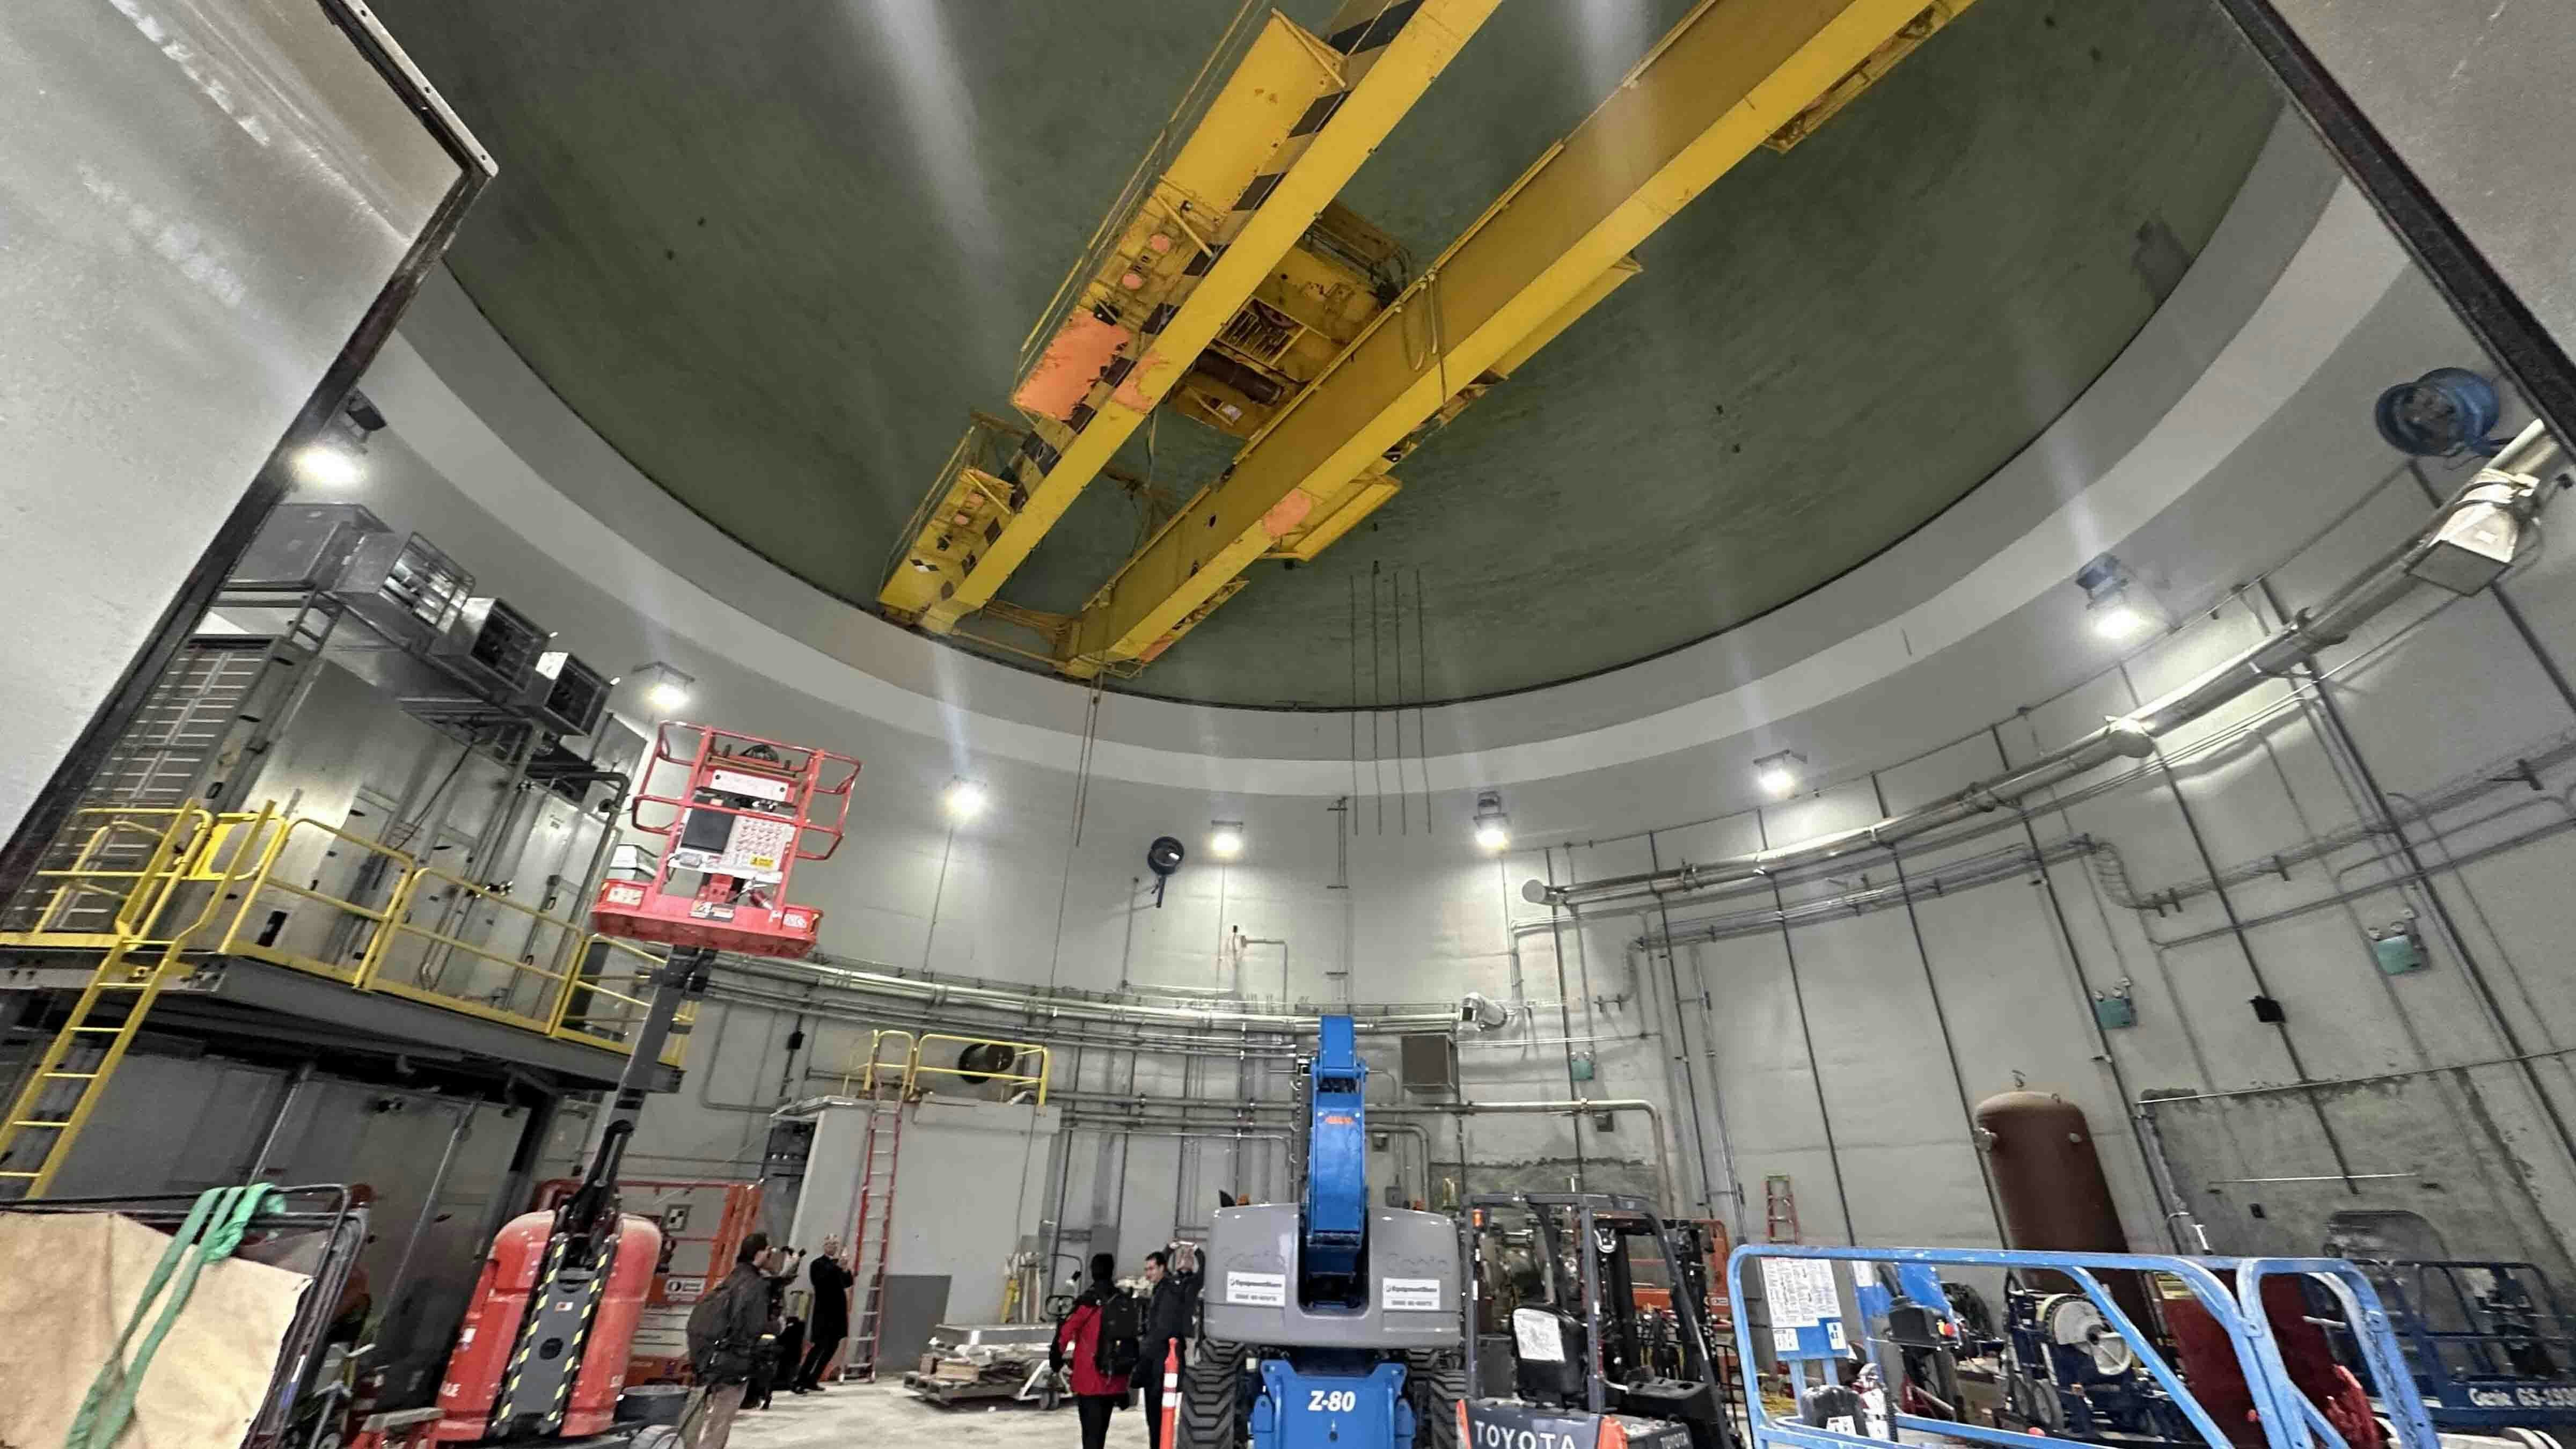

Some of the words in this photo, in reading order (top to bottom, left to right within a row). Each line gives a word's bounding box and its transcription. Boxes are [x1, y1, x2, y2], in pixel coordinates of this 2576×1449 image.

[1308, 1391, 1356, 1412] Z-80
[2468, 1388, 2514, 1407] Genie
[1475, 1421, 1576, 1449] TOYOTA
